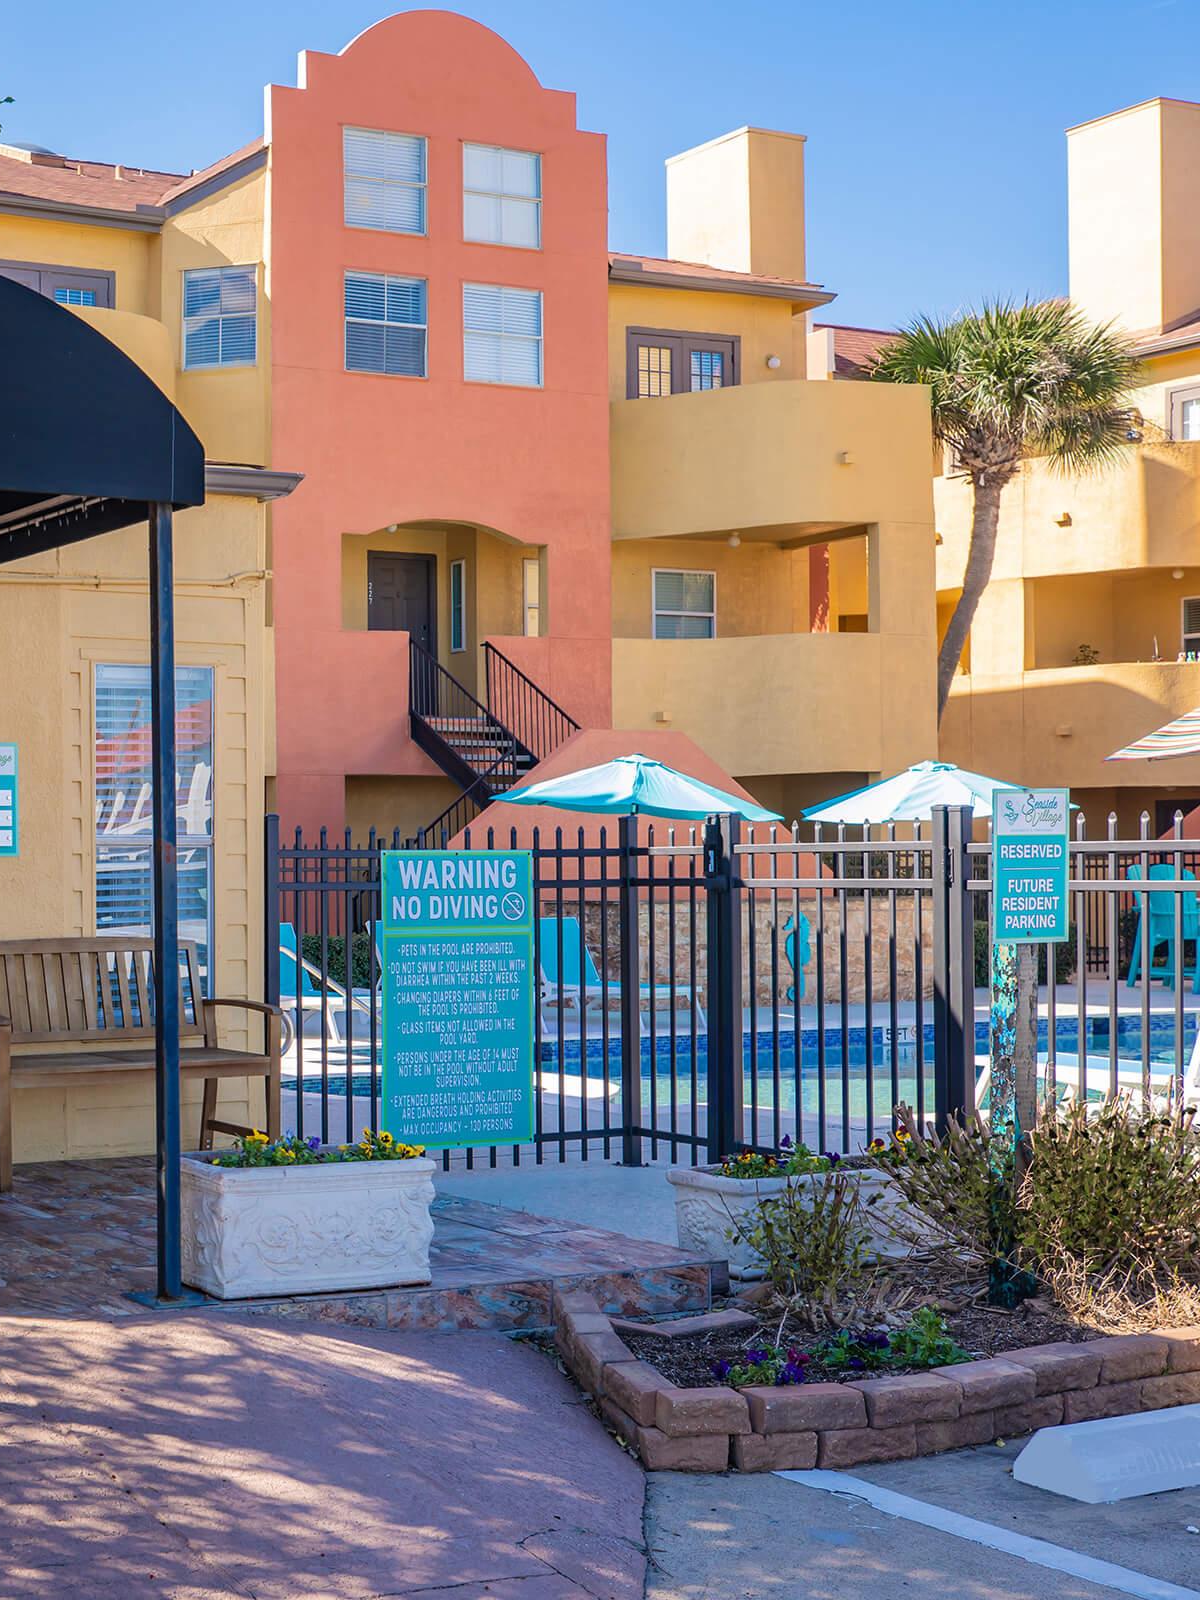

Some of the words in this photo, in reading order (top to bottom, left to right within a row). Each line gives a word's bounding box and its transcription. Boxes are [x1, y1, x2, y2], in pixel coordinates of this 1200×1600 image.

[1022, 796, 1058, 815] Seaside
[1025, 810, 1062, 827] Village
[1001, 844, 1062, 858] RESERVED
[399, 860, 516, 889] WARNING
[1008, 879, 1054, 893] FUTURE
[392, 895, 421, 920] NO
[429, 895, 498, 919] DIVING
[1002, 897, 1059, 911] RESIDENT
[1005, 914, 1056, 929] PARKING
[420, 944, 426, 956] IN
[428, 944, 439, 956] THE
[442, 943, 459, 955] POOL
[462, 943, 474, 955] ARE
[402, 962, 415, 974] NOT
[417, 961, 436, 973] SWIM
[438, 961, 444, 972] IF
[446, 961, 459, 972] YOU
[461, 961, 477, 972] HAVE
[480, 960, 496, 971] BEEN
[499, 960, 507, 971] ILL
[509, 959, 525, 971] WITH
[396, 974, 429, 987] DIARRHEA
[432, 974, 456, 986] WITHIN
[457, 973, 469, 984] THE
[471, 973, 487, 984] PAST
[489, 973, 493, 984] 2
[433, 991, 461, 1003] DIAPERS
[464, 990, 486, 1002] WITHIN
[489, 990, 492, 1001] 6
[495, 990, 509, 1000] FEET
[512, 989, 519, 1000] OF
[419, 1004, 429, 1016] THE
[432, 1004, 449, 1016] POOL
[452, 1003, 457, 1015] IS
[426, 1021, 445, 1033] ITEMS
[447, 1021, 460, 1032] NOT
[462, 1019, 493, 1031] ALLOWED
[495, 1019, 501, 1031] IN
[504, 1018, 515, 1030] THE
[440, 1034, 456, 1045] POOL
[431, 1051, 451, 1063] UNDER
[454, 1050, 466, 1062] THE
[468, 1050, 480, 1061] AGE
[483, 1049, 490, 1061] OF
[502, 1048, 519, 1059] MUST
[399, 1065, 412, 1077] NOT
[414, 1065, 421, 1076] BE
[424, 1064, 431, 1075] IN
[433, 1064, 444, 1075] THE
[447, 1063, 463, 1074] POOL
[466, 1062, 495, 1074] WITHOUT
[497, 1061, 517, 1072] ADULT
[431, 1093, 455, 1105] BREATH
[458, 1092, 485, 1104] HOLDING
[488, 1090, 522, 1103] ACTIVITIES
[402, 1107, 415, 1120] ARE
[417, 1105, 457, 1119] DANGEROUS
[460, 1105, 473, 1116] AND
[421, 1121, 462, 1135] OCCUPANCY
[483, 1119, 513, 1131] PERSONS
